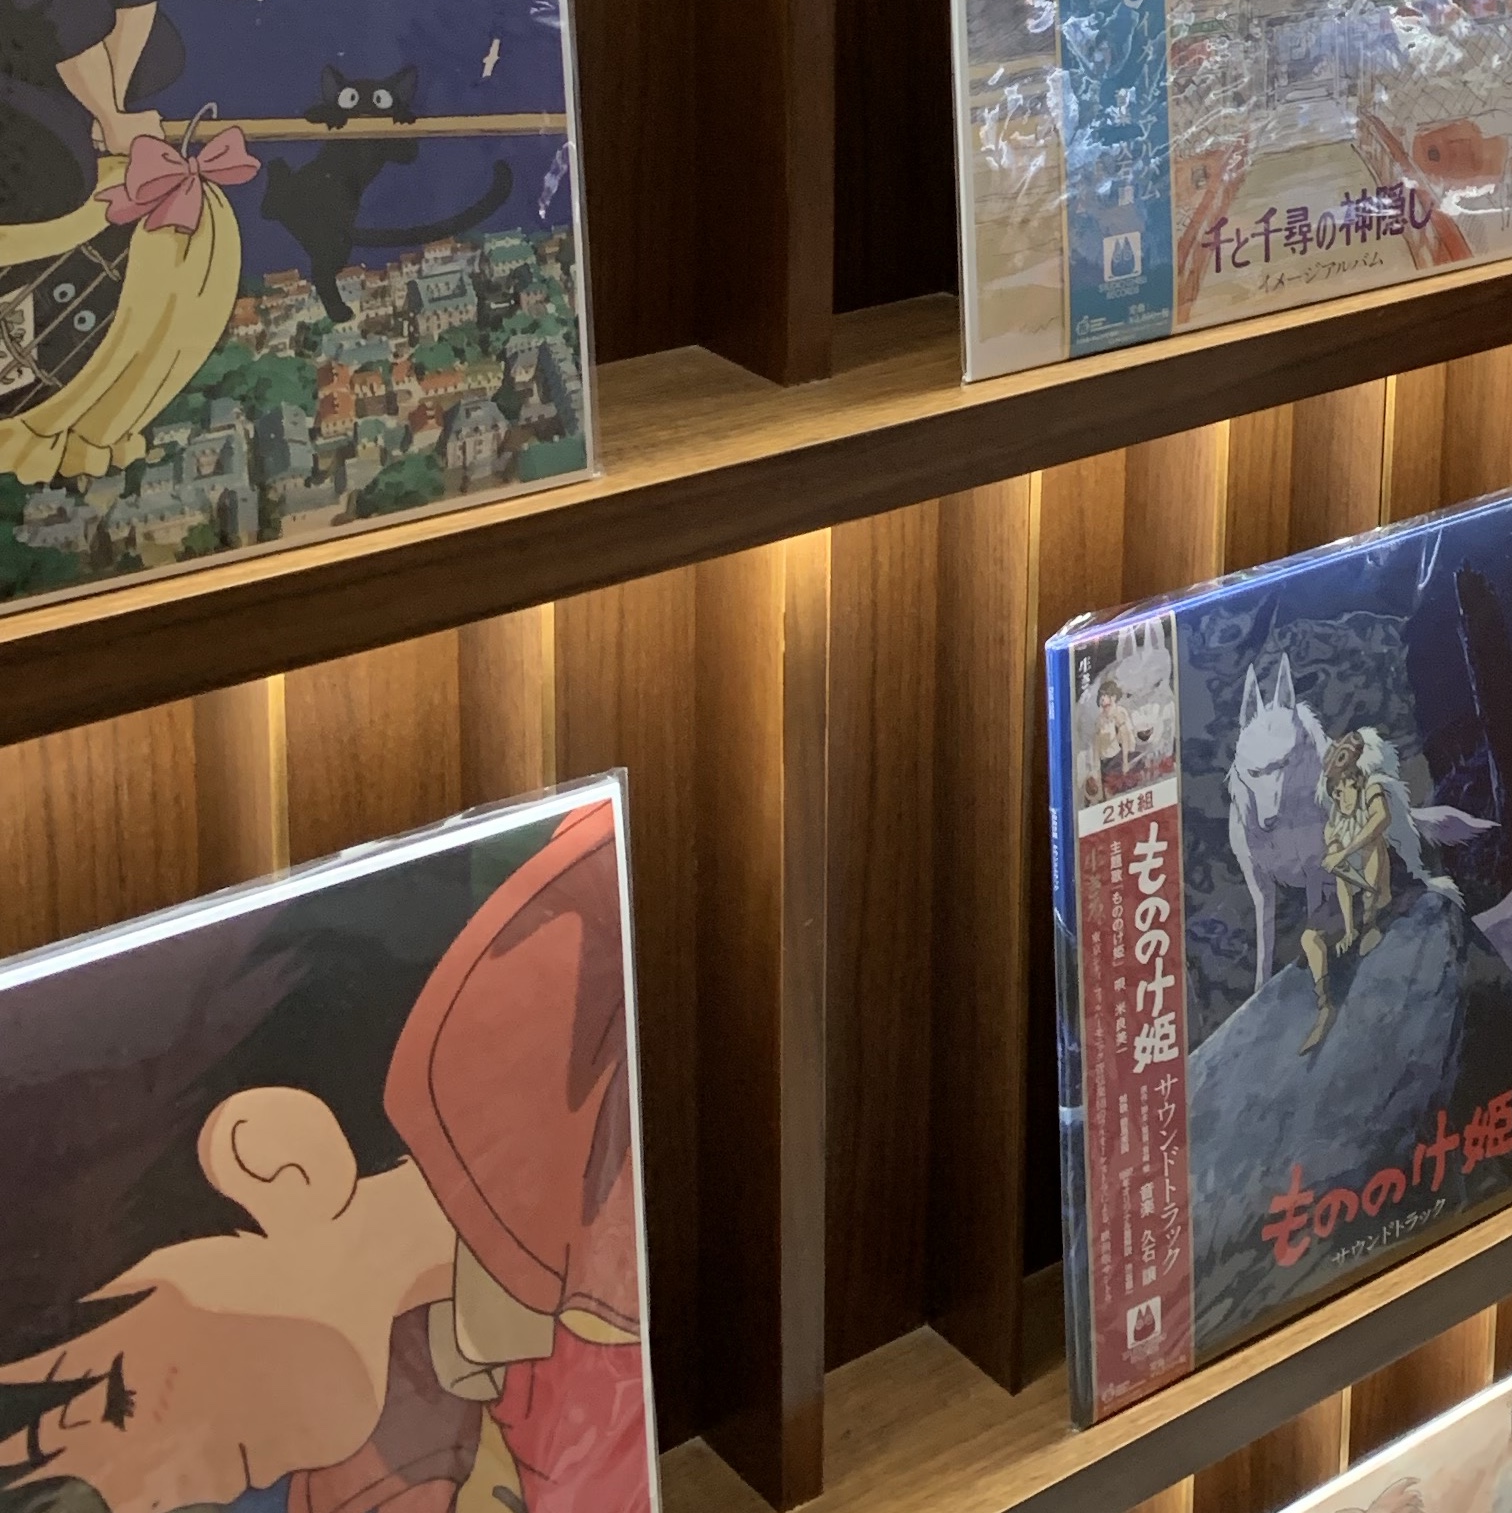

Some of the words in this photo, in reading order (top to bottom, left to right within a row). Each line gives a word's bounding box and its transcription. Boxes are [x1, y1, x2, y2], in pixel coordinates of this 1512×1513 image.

[1201, 181, 1434, 274] 千と千尋の神隠し
[1257, 251, 1385, 294] イメージアルバム
[1102, 790, 1154, 826] 2枚組
[1128, 821, 1180, 1074] もののけ姫
[1154, 1073, 1182, 1276] サウンドトラック
[1331, 1197, 1447, 1267] サウンドトラック
